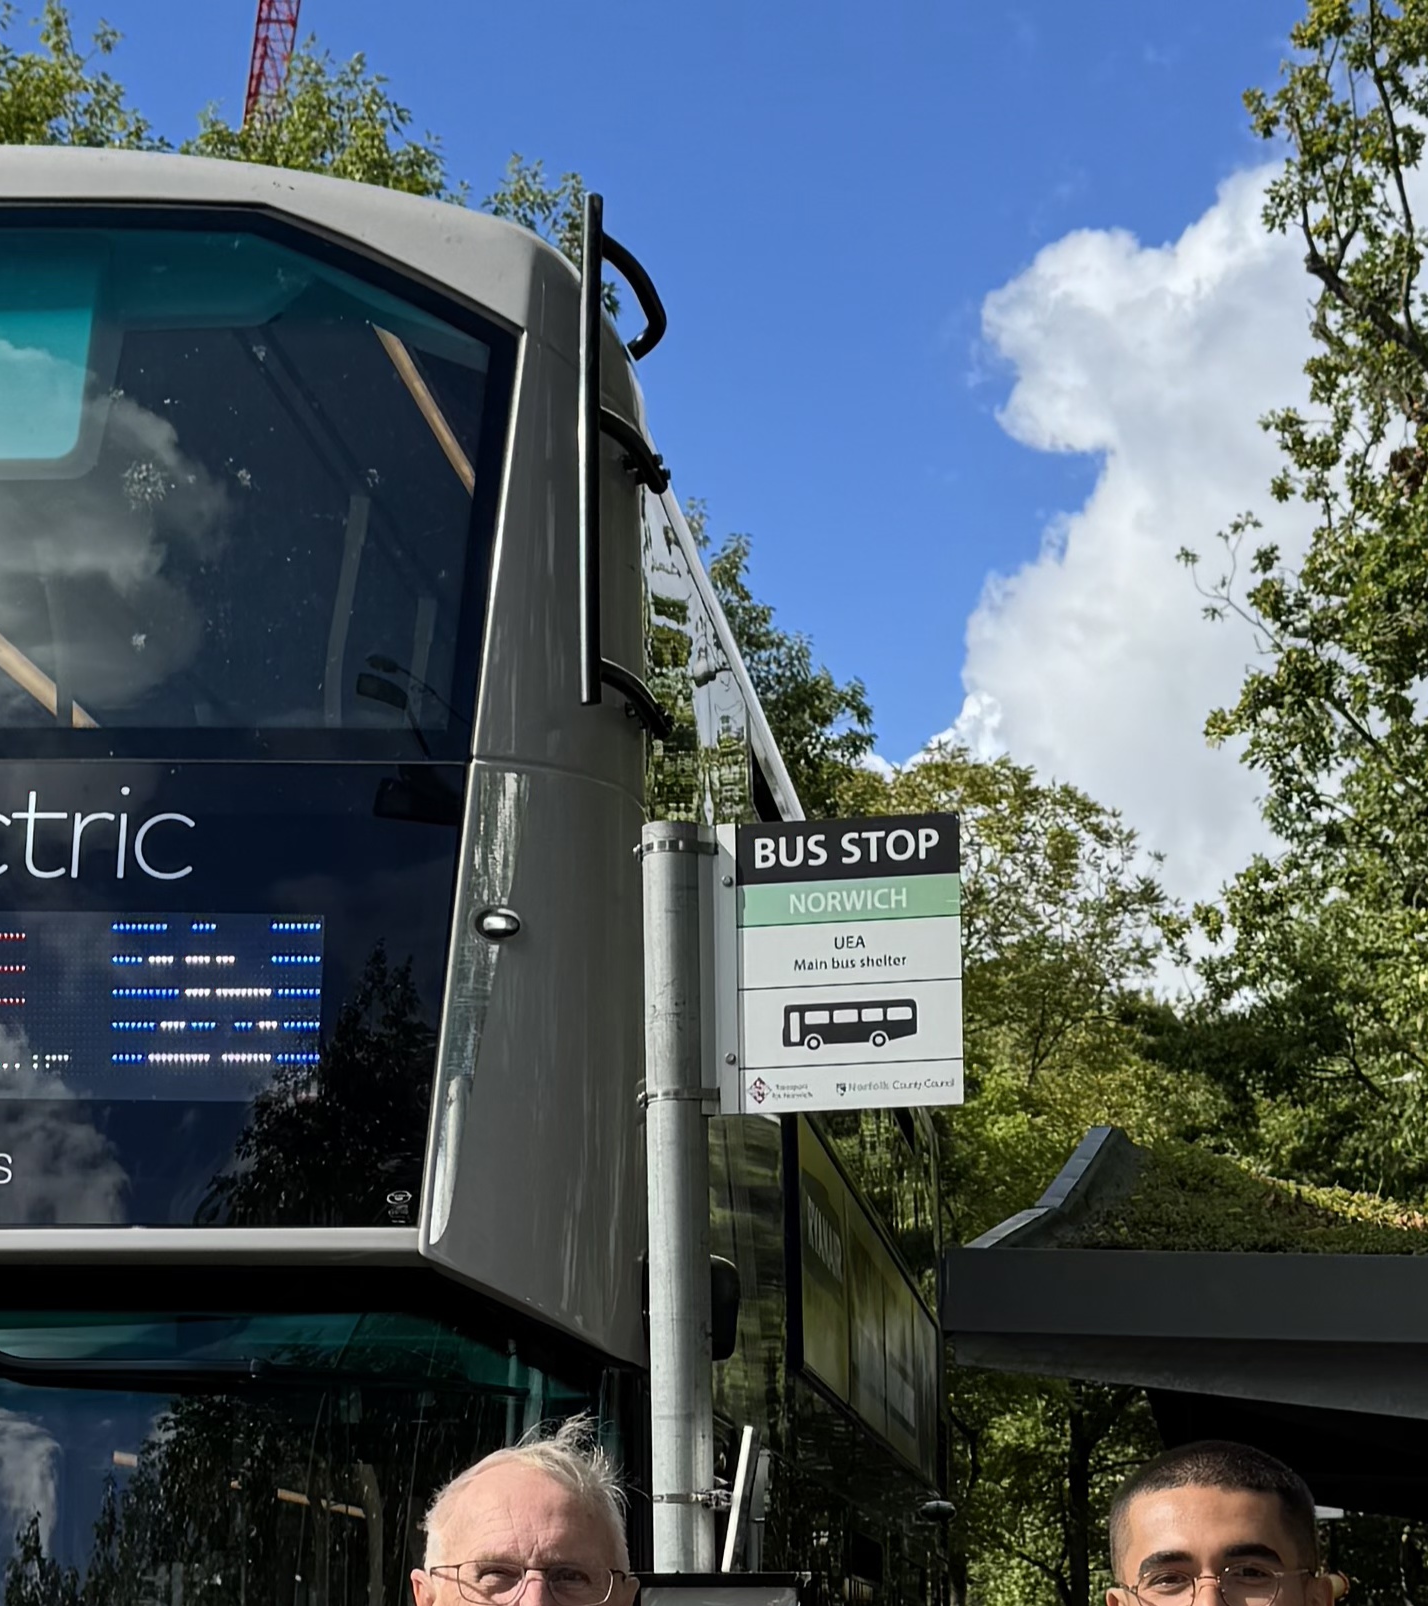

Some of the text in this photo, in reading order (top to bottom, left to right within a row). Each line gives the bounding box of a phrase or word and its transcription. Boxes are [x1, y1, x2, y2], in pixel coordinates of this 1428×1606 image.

[753, 828, 940, 870] BUS STOP
[789, 887, 907, 915] NORWICH
[833, 935, 866, 950] UEA
[793, 954, 907, 972] Main bus shelter
